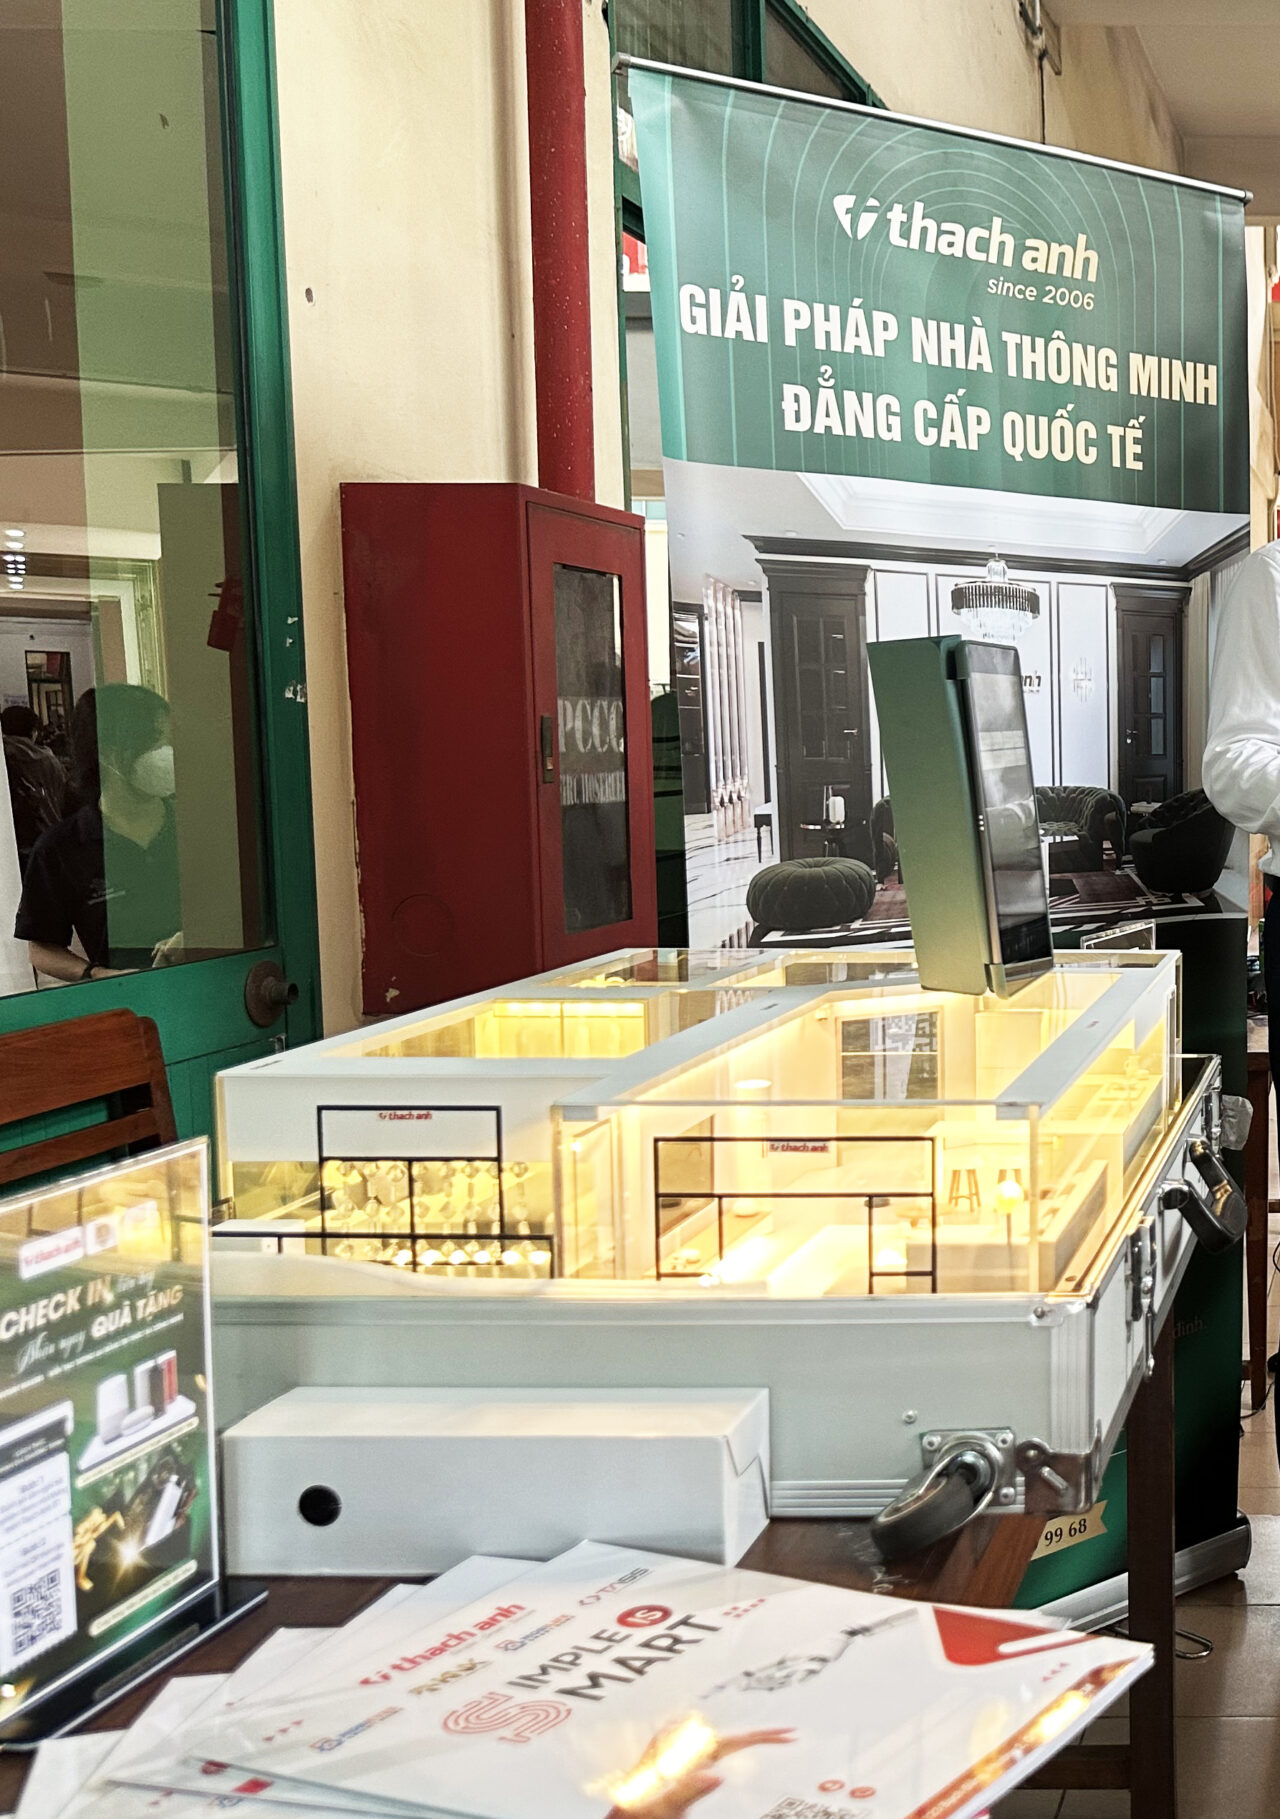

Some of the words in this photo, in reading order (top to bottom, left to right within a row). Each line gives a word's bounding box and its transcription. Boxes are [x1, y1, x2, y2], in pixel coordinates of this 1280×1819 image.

[886, 199, 1015, 267] thach
[1022, 234, 1100, 283] anh
[987, 276, 1038, 303] since
[1043, 285, 1096, 311] 2006
[679, 275, 768, 343] GIẢI
[783, 298, 899, 358] PHÁP
[911, 317, 993, 375] NHÀ
[1002, 330, 1119, 394] THÔNG
[1129, 352, 1219, 407] MINH
[782, 364, 903, 443] ĐẲNG
[914, 388, 991, 453] CẤP
[1003, 403, 1099, 464] QUỐC
[1107, 415, 1147, 471] TẾ
[557, 699, 624, 753] PCCC
[0, 1286, 83, 1342] CHECK
[86, 1275, 115, 1307] IN
[1043, 1527, 1063, 1547] 99
[1068, 1518, 1088, 1537] 68
[390, 1630, 478, 1673] thach
[472, 1603, 526, 1632] anh
[506, 1627, 634, 1690] IMPLE
[554, 1613, 723, 1701] MART
